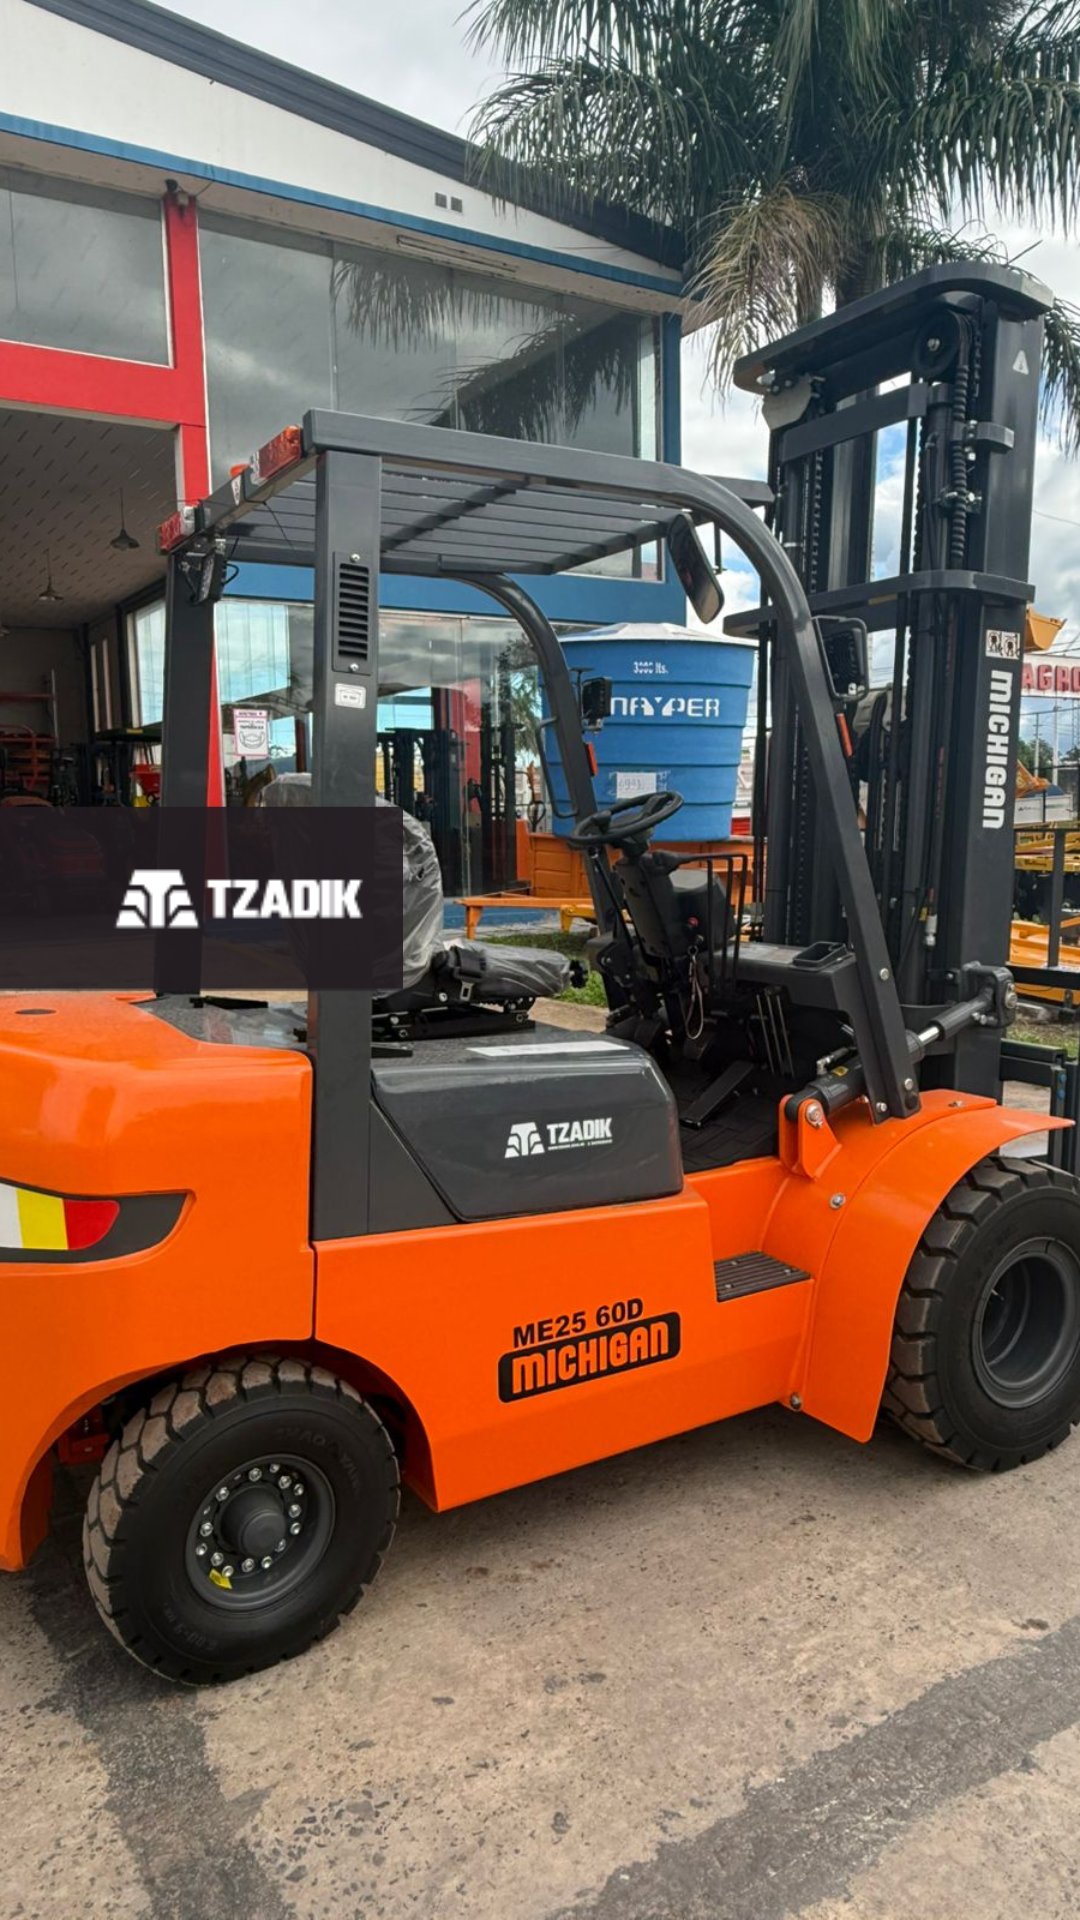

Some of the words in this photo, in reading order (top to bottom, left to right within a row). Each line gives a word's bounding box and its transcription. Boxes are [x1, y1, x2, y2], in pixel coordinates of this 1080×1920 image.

[982, 669, 1013, 829] MICHIGAN
[546, 1117, 612, 1145] TZADIK
[513, 1311, 586, 1348] ME25
[596, 1298, 643, 1327] 60D
[512, 1321, 669, 1394] MICHIGAN
